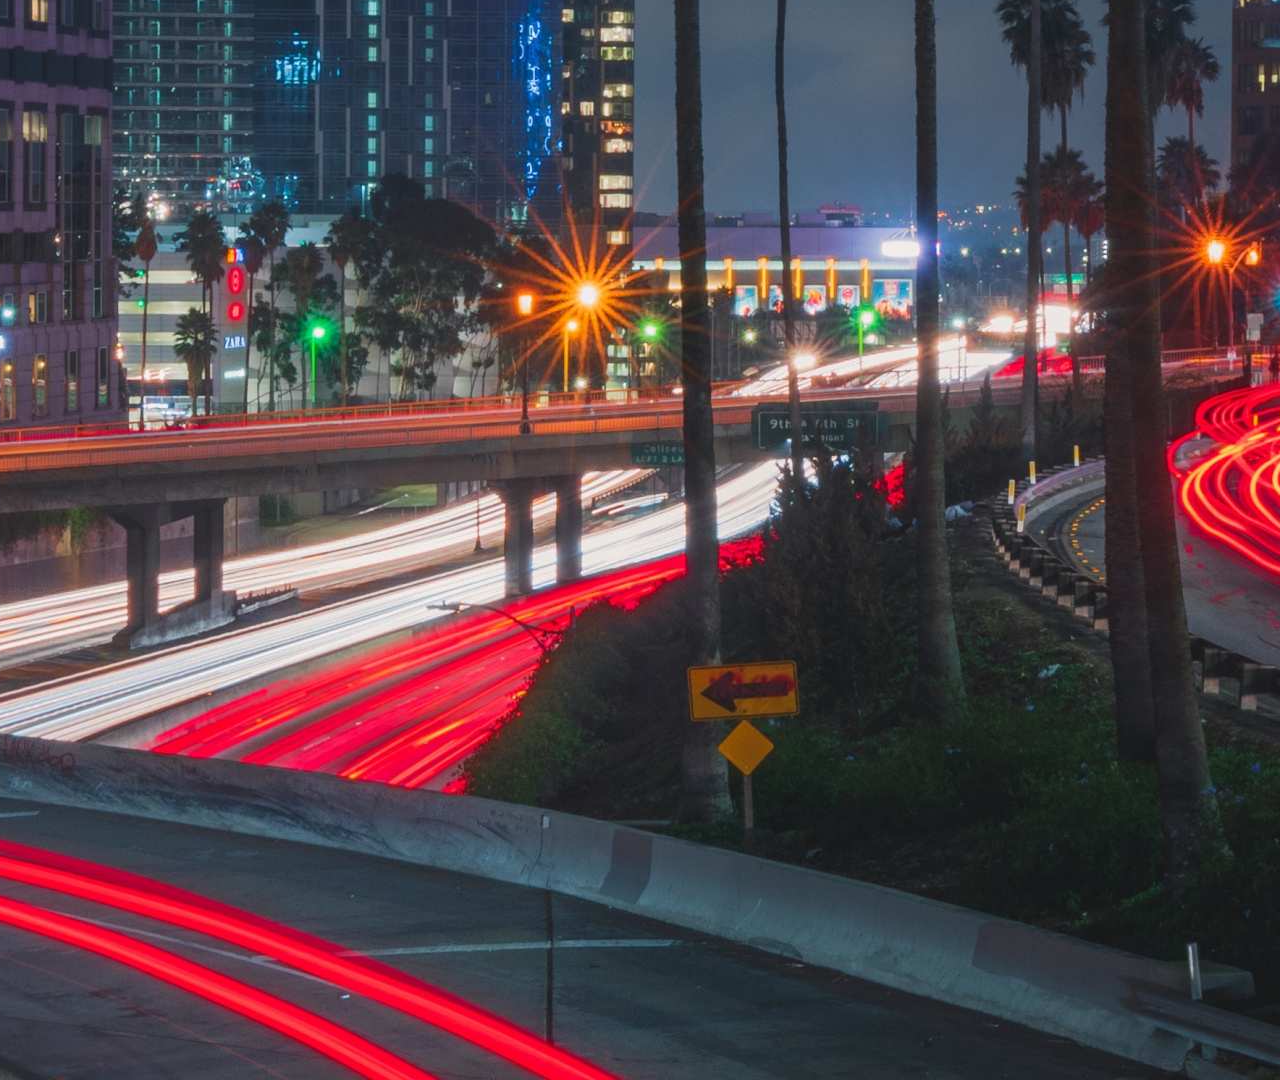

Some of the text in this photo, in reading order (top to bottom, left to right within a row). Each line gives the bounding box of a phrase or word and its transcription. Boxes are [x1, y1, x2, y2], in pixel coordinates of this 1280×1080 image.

[224, 336, 246, 349] ZARA
[770, 418, 792, 429] 9th
[643, 444, 685, 453] Coliseu
[662, 455, 668, 463] 2
[671, 455, 684, 463] LA
